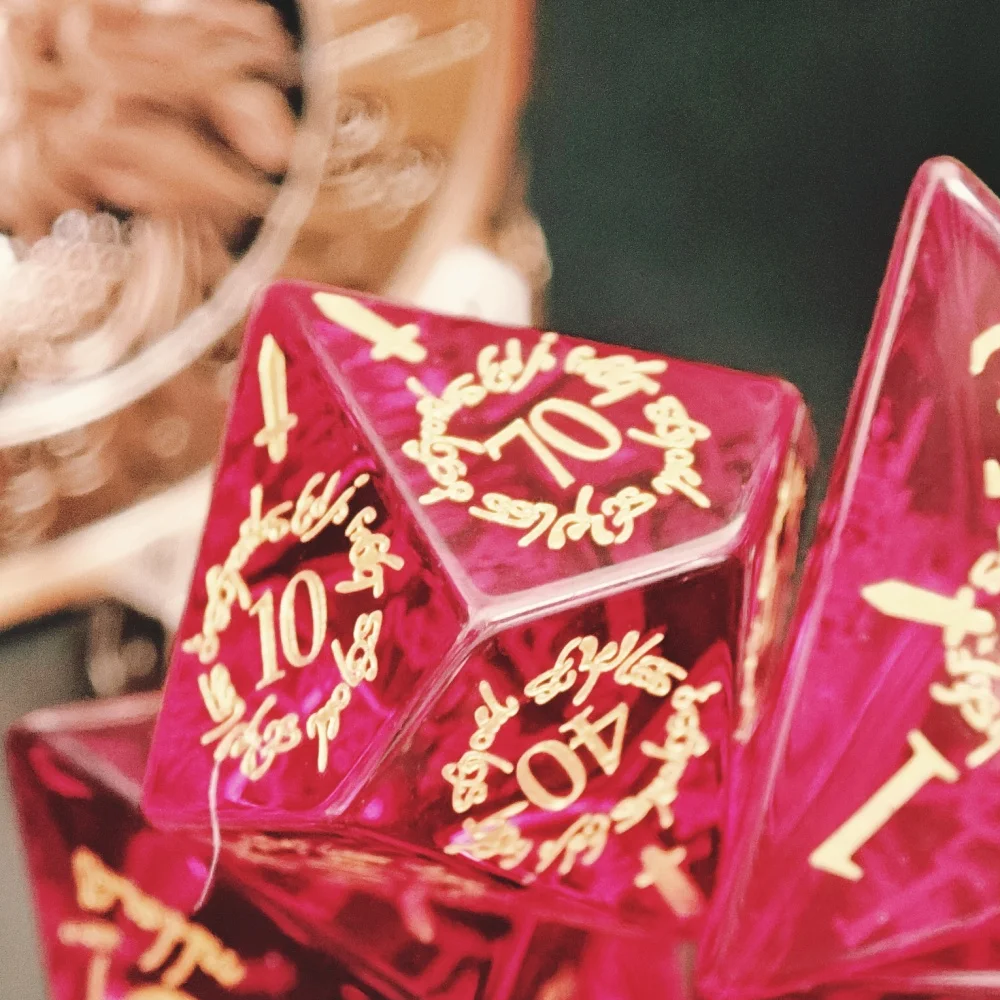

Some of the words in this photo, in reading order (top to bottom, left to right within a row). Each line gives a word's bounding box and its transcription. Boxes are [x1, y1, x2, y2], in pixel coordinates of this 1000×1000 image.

[483, 397, 622, 489] 70
[247, 570, 328, 690] 10
[516, 702, 628, 812] 40
[809, 730, 959, 880] 1
